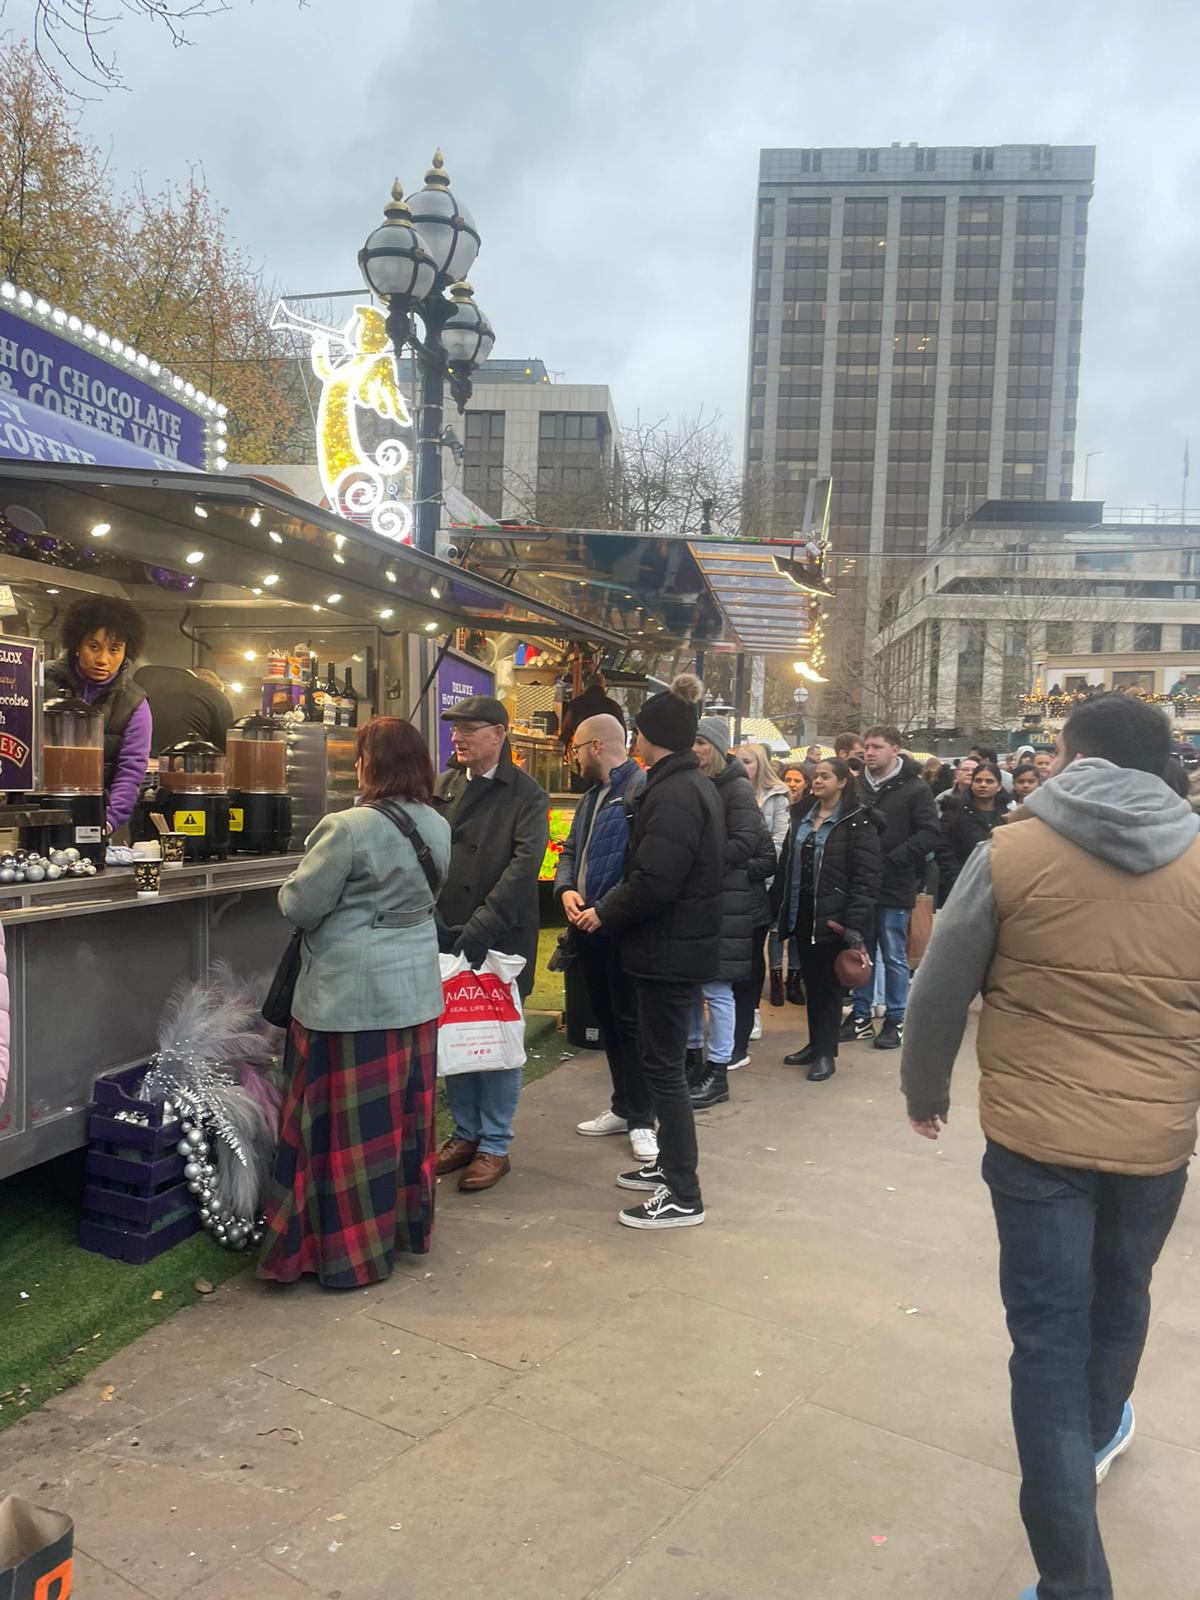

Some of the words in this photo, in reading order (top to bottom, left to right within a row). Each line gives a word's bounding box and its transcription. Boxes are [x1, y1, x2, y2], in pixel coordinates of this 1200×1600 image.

[0, 336, 54, 385] HOT
[59, 365, 182, 441] CHOCOLATE
[28, 383, 125, 439] COFFEE
[130, 423, 179, 461] VAN
[441, 693, 454, 706] HOT
[452, 681, 473, 696] DELUXE
